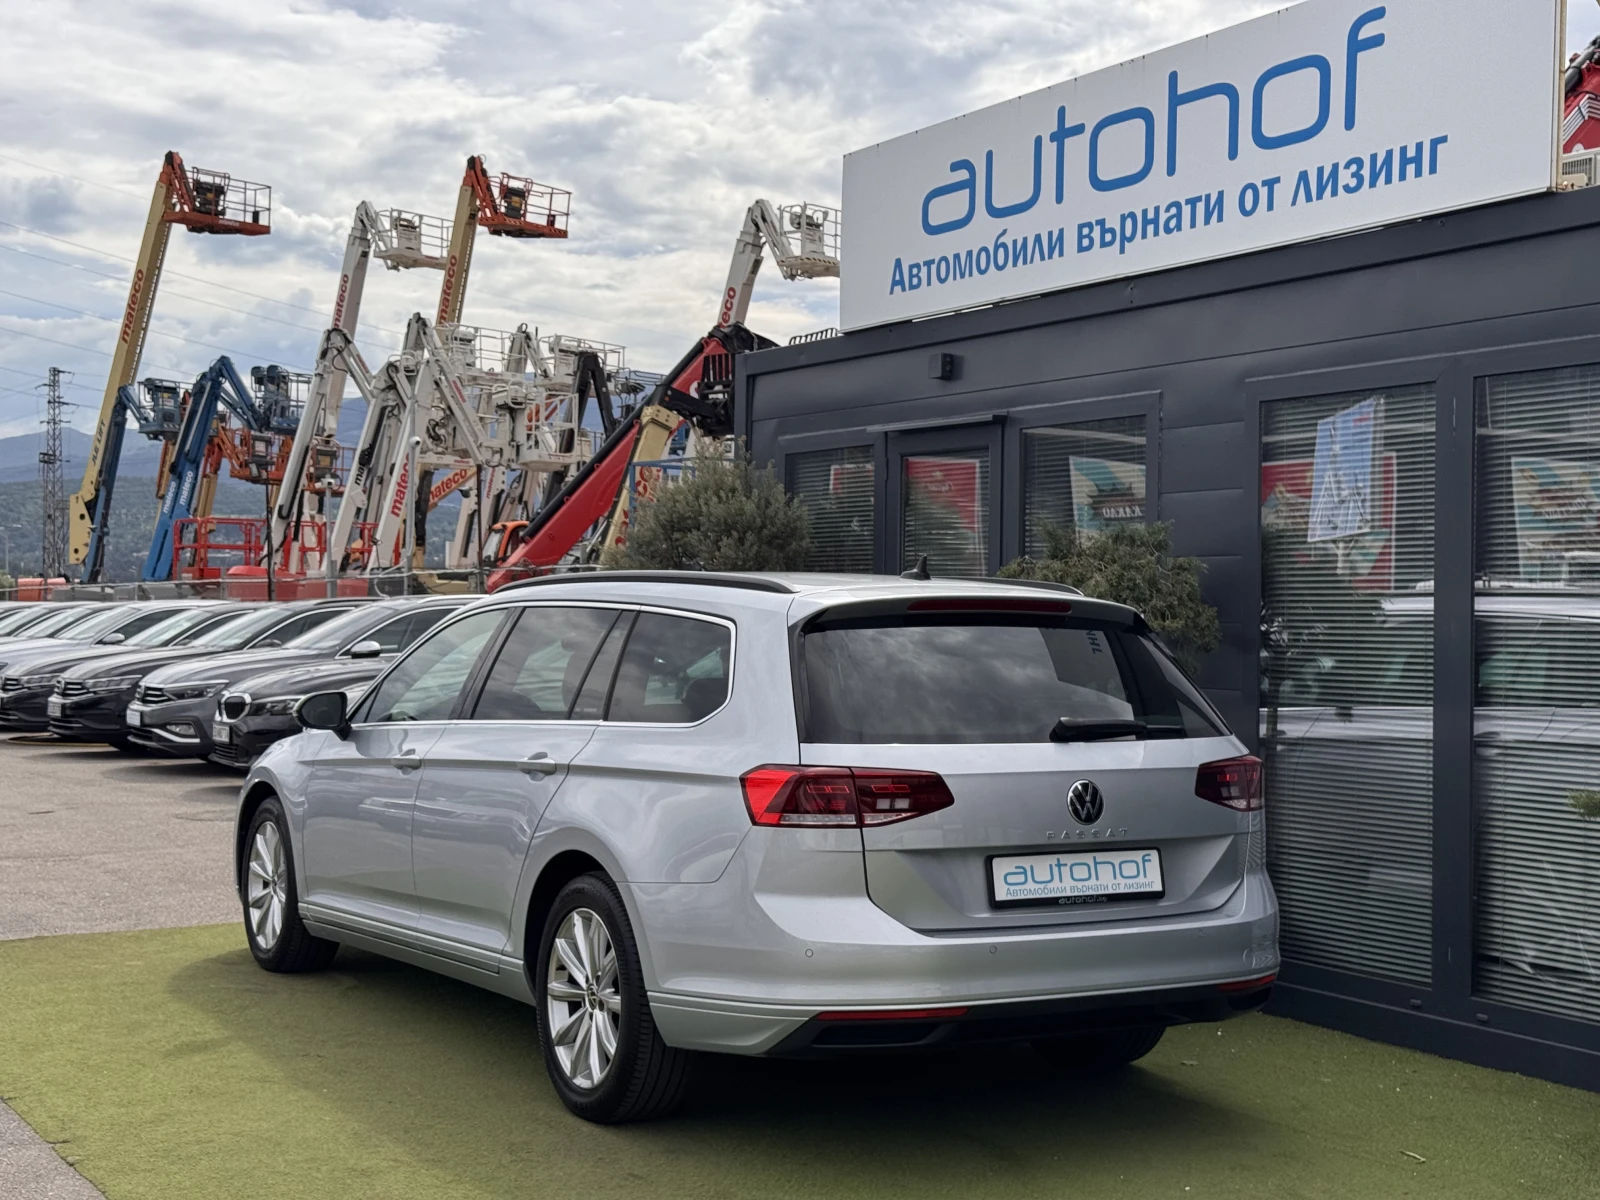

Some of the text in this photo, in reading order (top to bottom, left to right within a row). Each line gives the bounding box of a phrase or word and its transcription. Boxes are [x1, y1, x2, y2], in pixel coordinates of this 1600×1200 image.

[921, 6, 1386, 236] autohof
[889, 134, 1449, 294] Автомобили върнати от лизинг
[121, 268, 145, 345] mateco
[718, 286, 736, 329] teco
[179, 470, 194, 506] mateco
[1046, 828, 1128, 840] PASSAT
[1003, 853, 1152, 887] autohof
[1005, 880, 1155, 898] Автомобили върнати от лизинг
